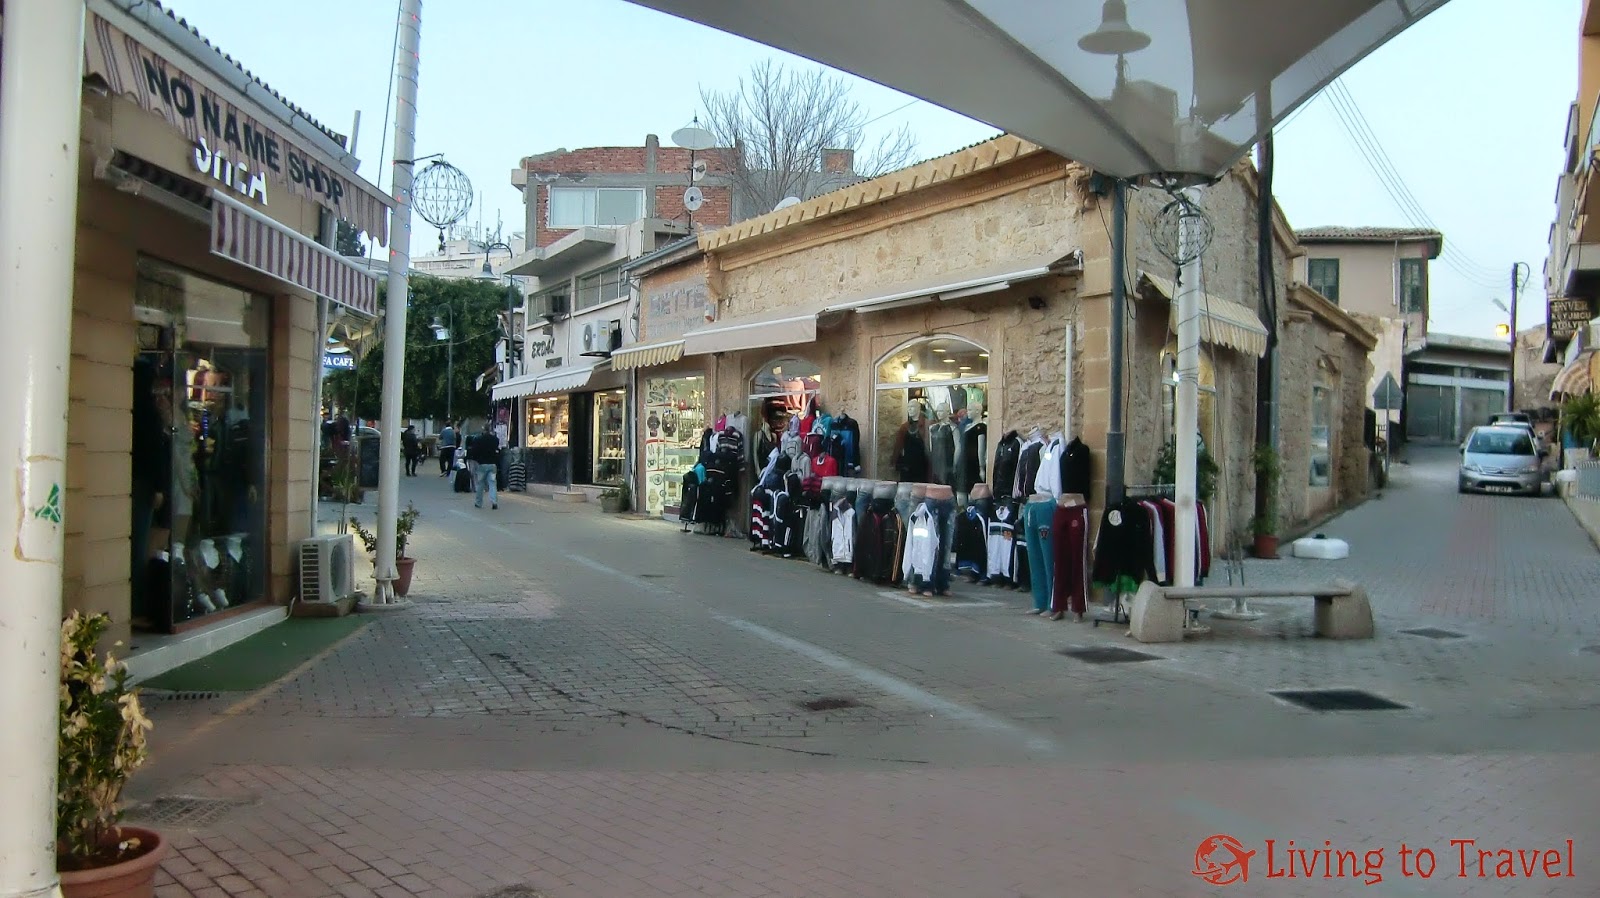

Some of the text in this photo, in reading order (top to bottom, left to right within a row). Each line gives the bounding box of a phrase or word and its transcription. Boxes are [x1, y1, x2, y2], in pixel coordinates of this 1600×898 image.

[142, 57, 344, 205] NO NAME SHOP
